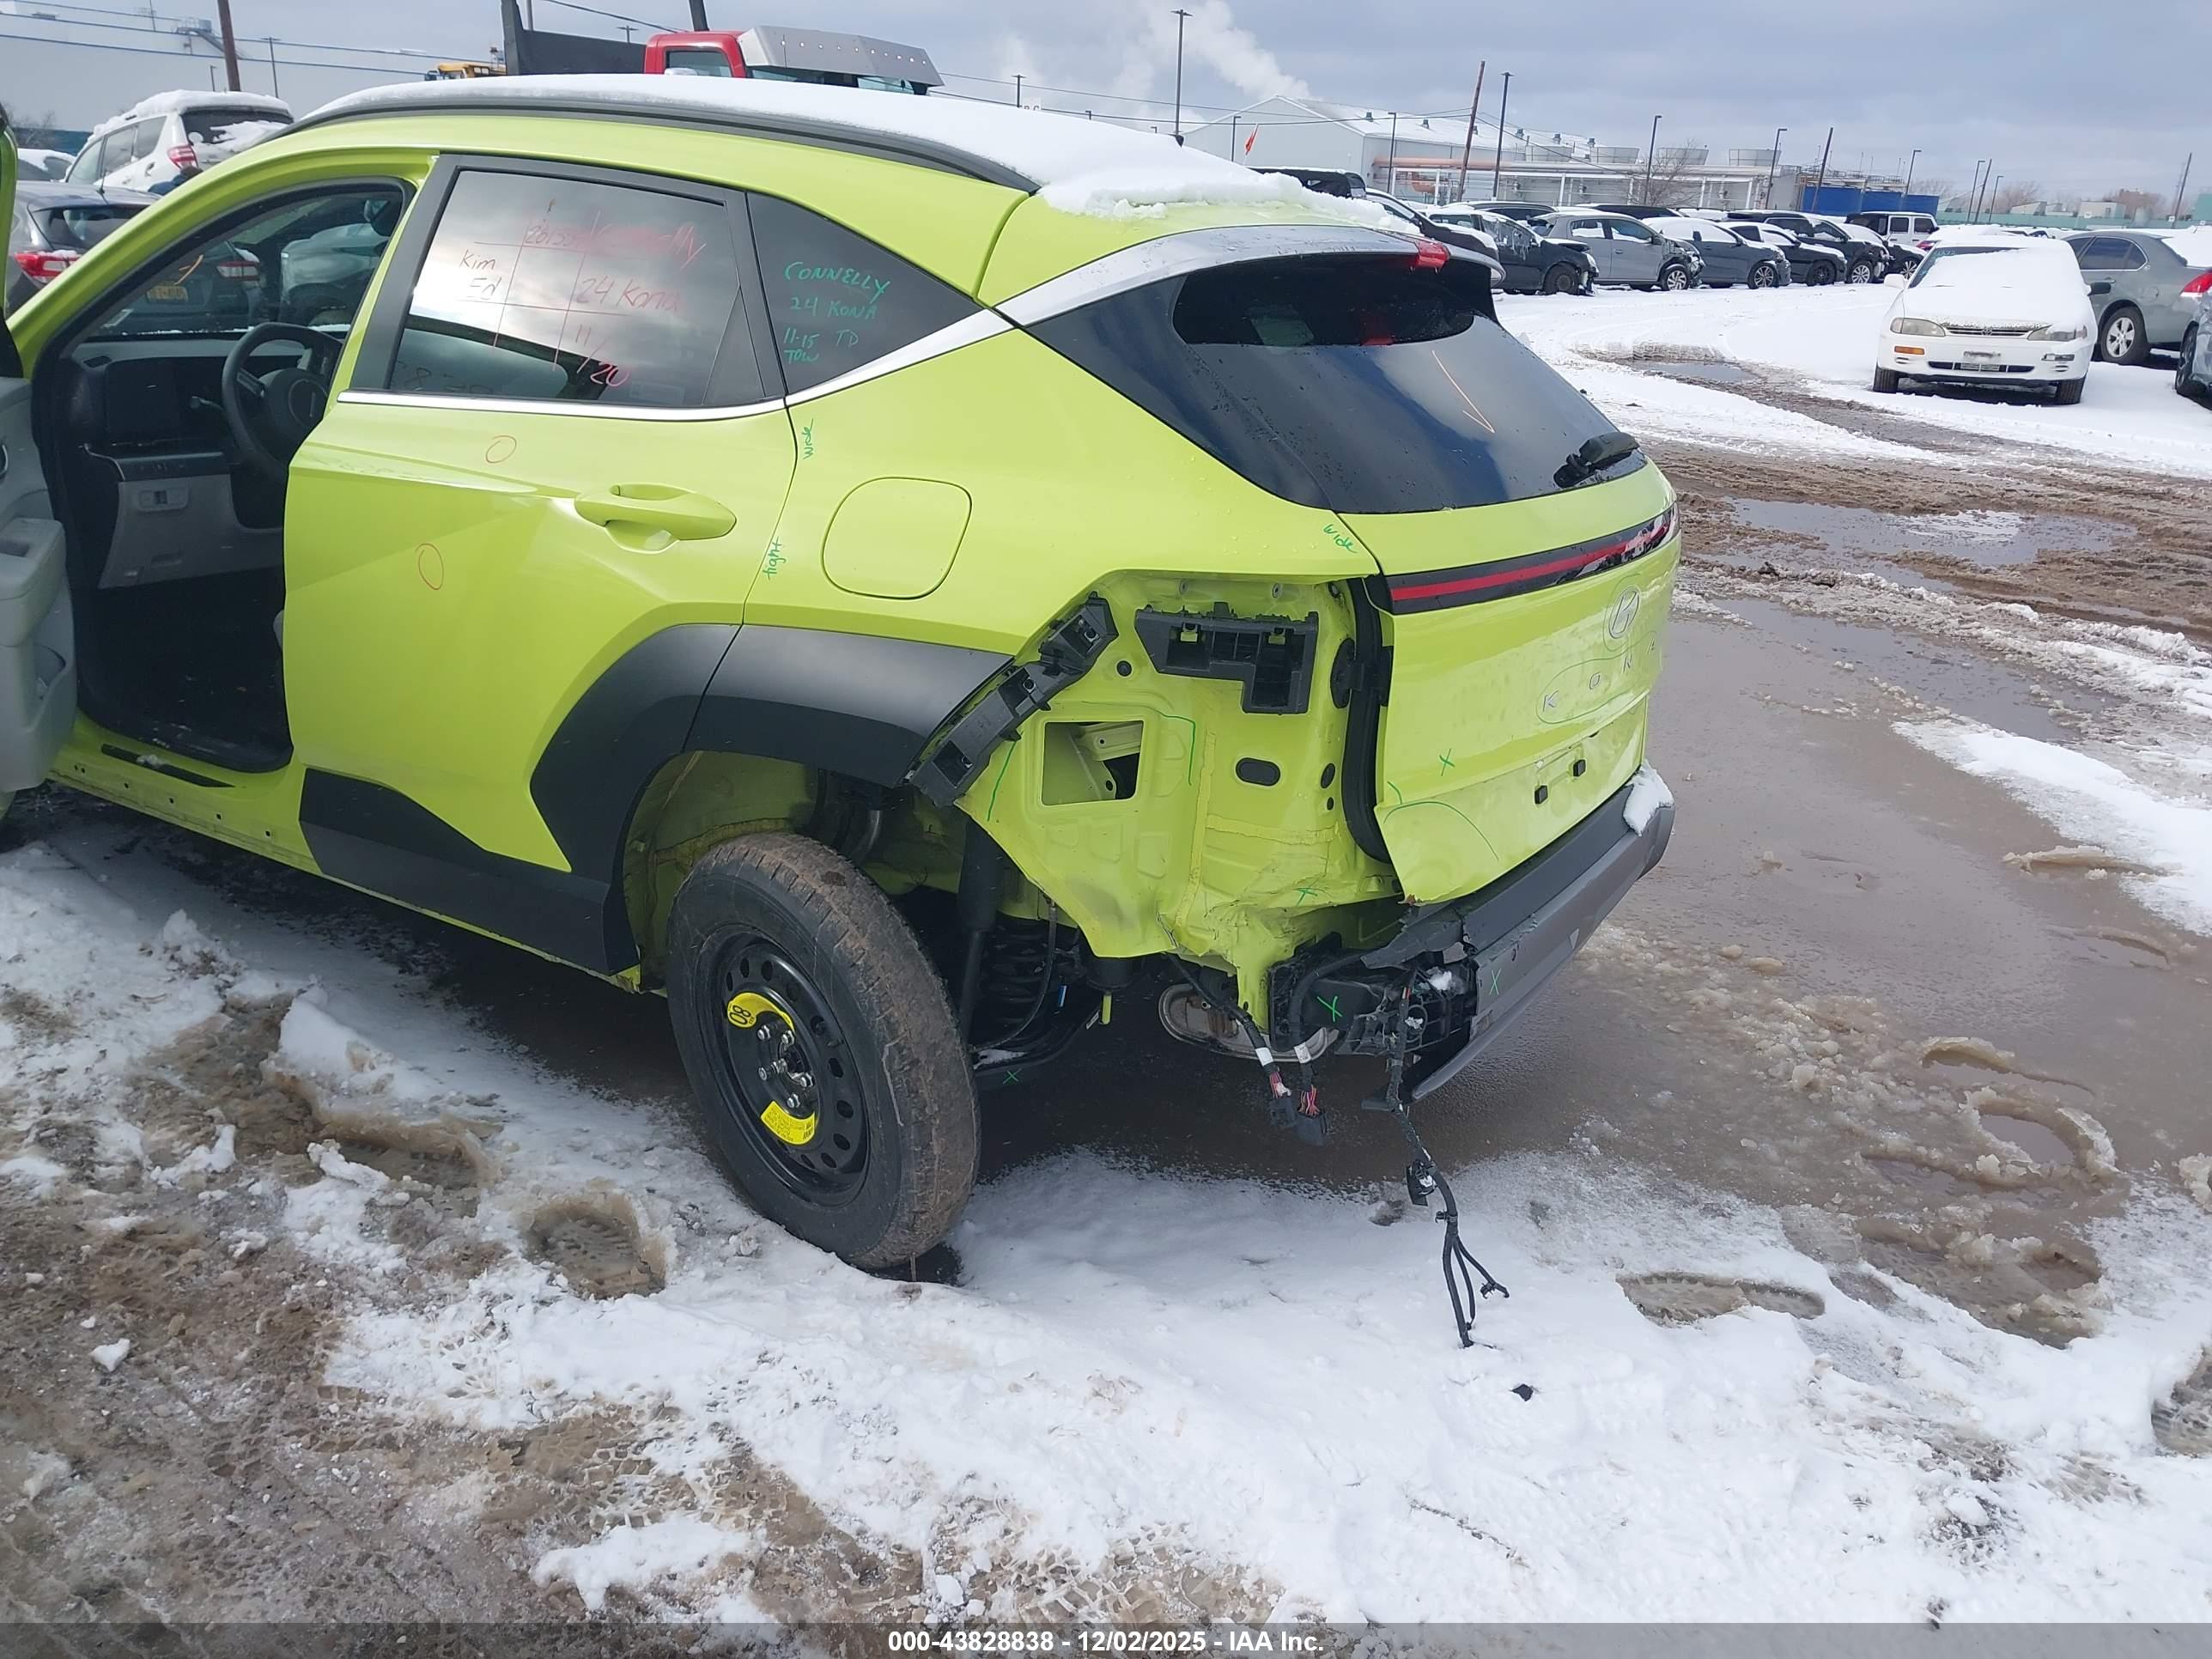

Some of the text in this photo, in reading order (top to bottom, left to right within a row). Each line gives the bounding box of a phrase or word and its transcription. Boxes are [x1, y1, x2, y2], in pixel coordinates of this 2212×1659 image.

[459, 248, 496, 271] Kim
[573, 276, 615, 305] 24
[784, 261, 890, 304] CONNELLY
[790, 296, 878, 320] 24 KONA
[783, 327, 860, 349] 11-15 TD
[783, 349, 820, 365] TOW
